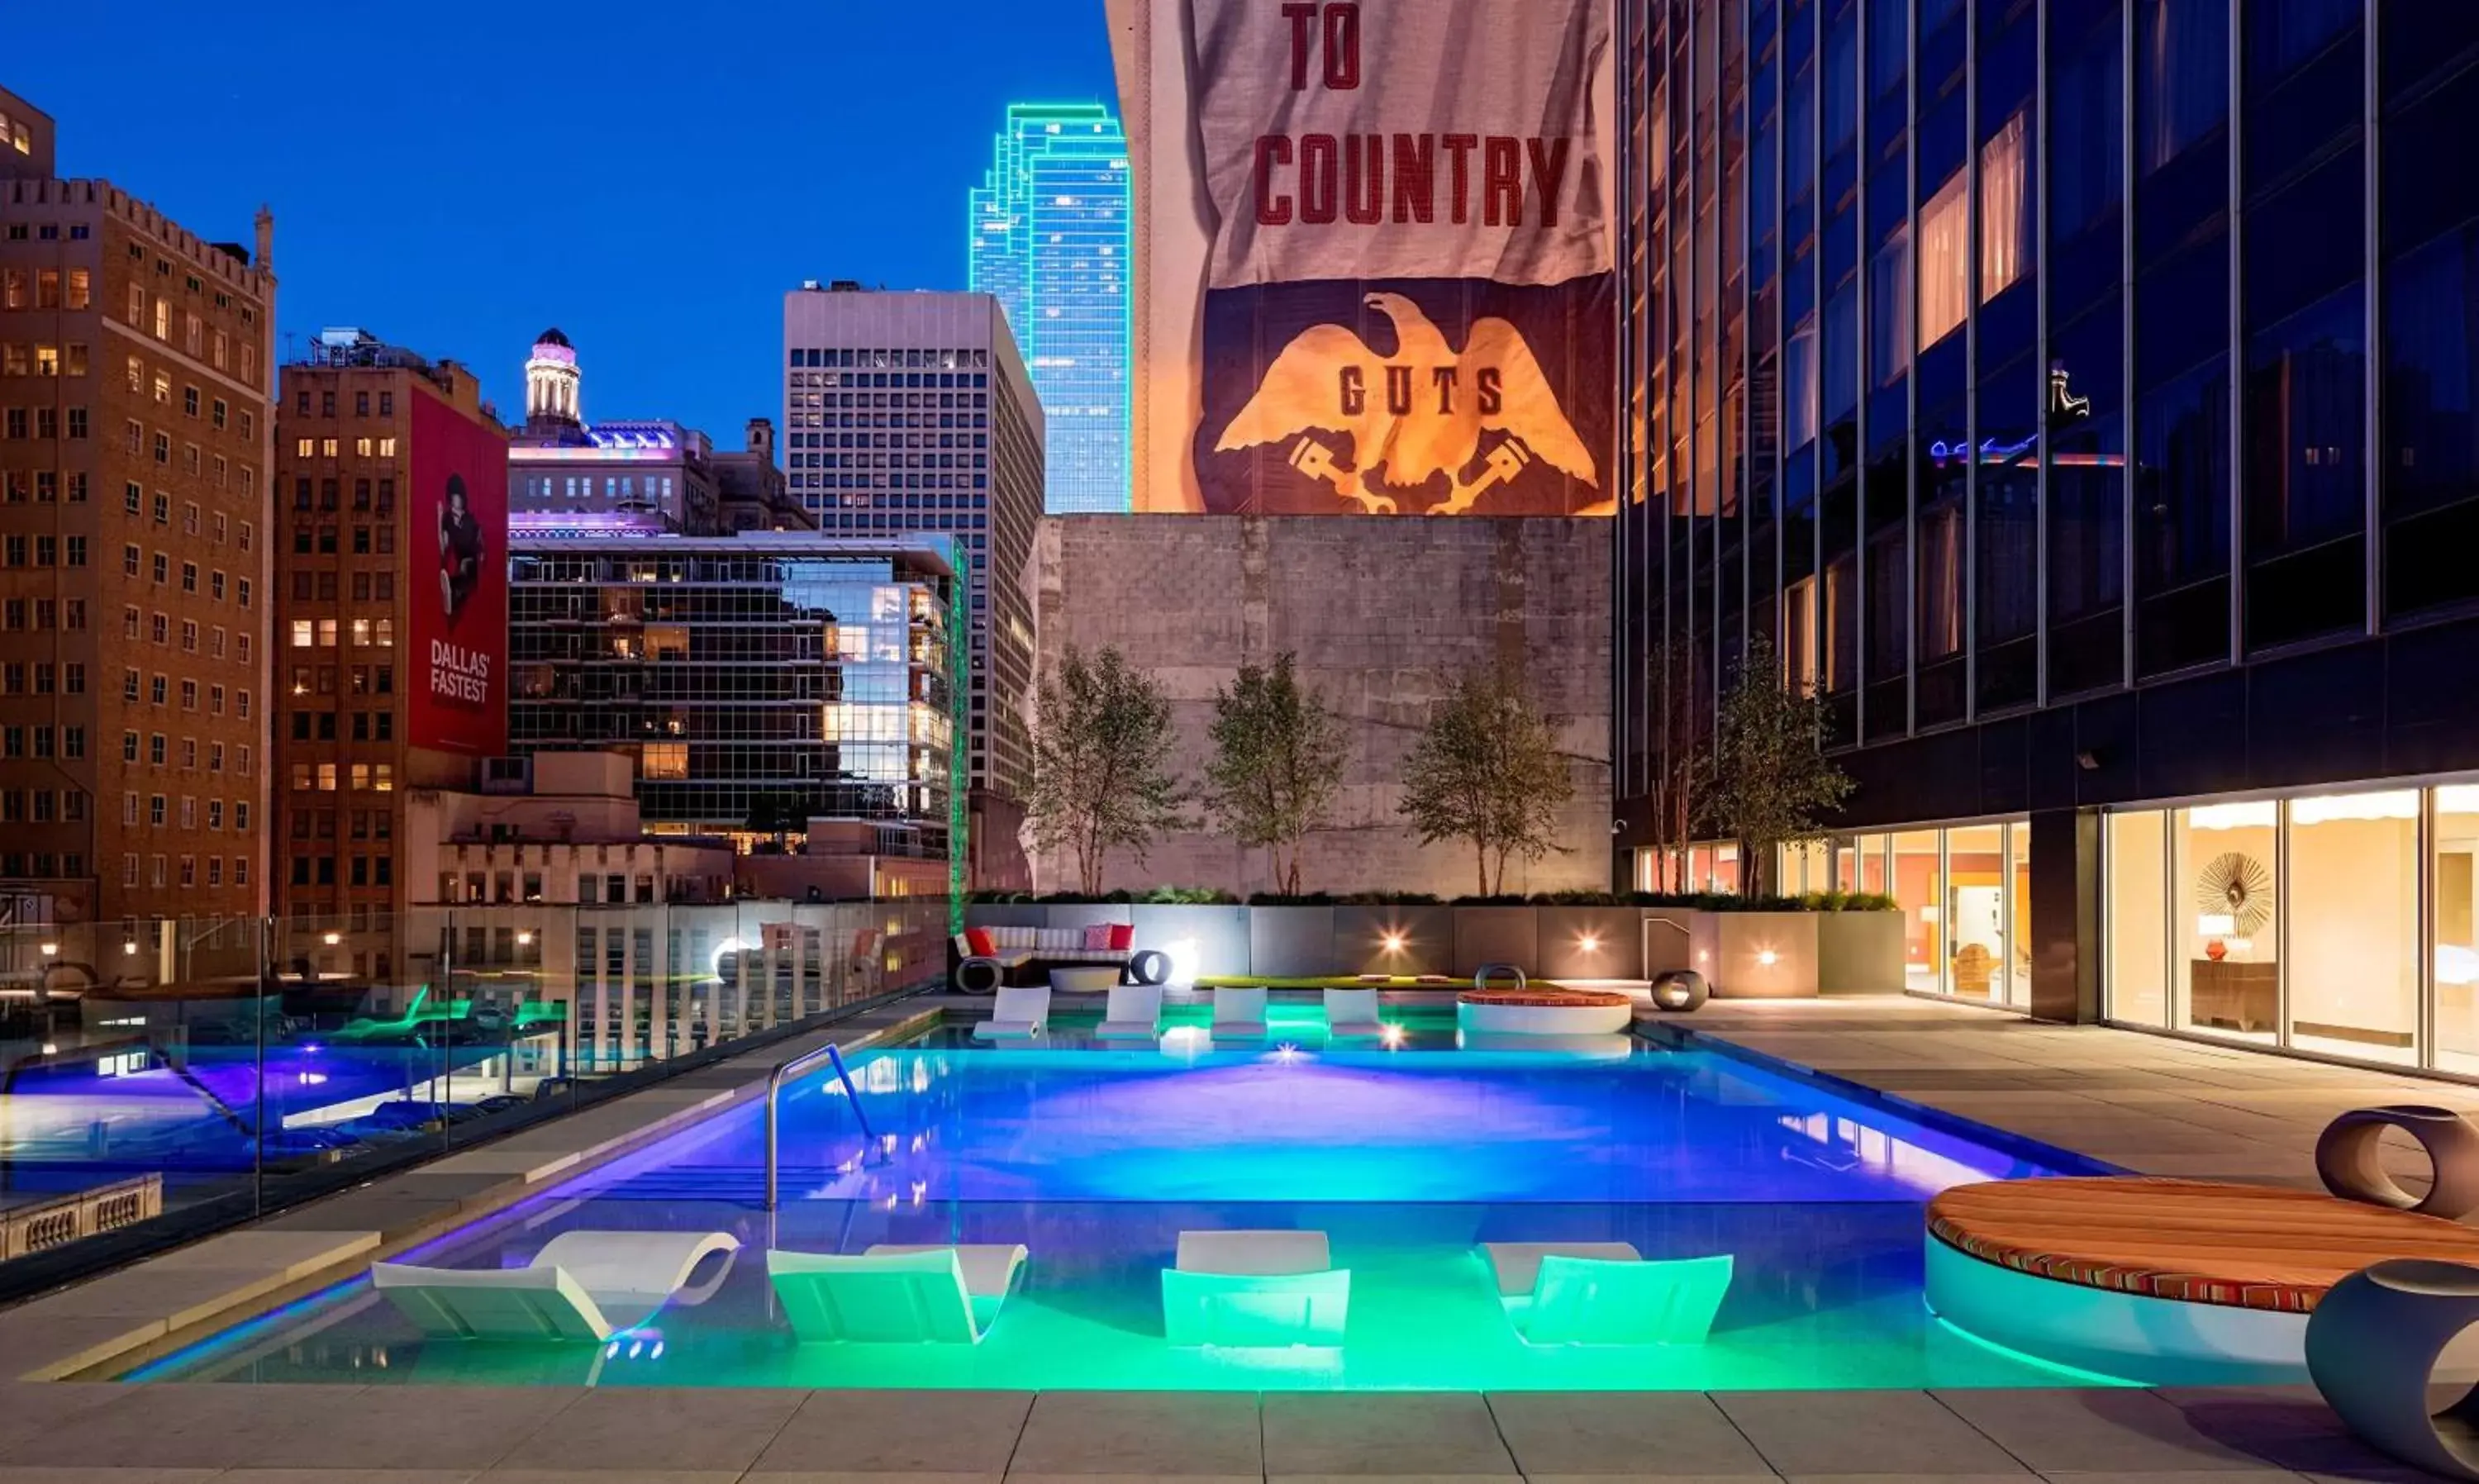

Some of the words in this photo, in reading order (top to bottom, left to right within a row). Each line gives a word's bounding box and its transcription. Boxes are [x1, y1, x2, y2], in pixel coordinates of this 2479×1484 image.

[1282, 2, 1360, 90] TO
[1254, 133, 1570, 227] COUNTRY
[1339, 366, 1501, 416] GUTS
[431, 639, 490, 678] DALLAS'
[431, 667, 488, 703] FASTEST
